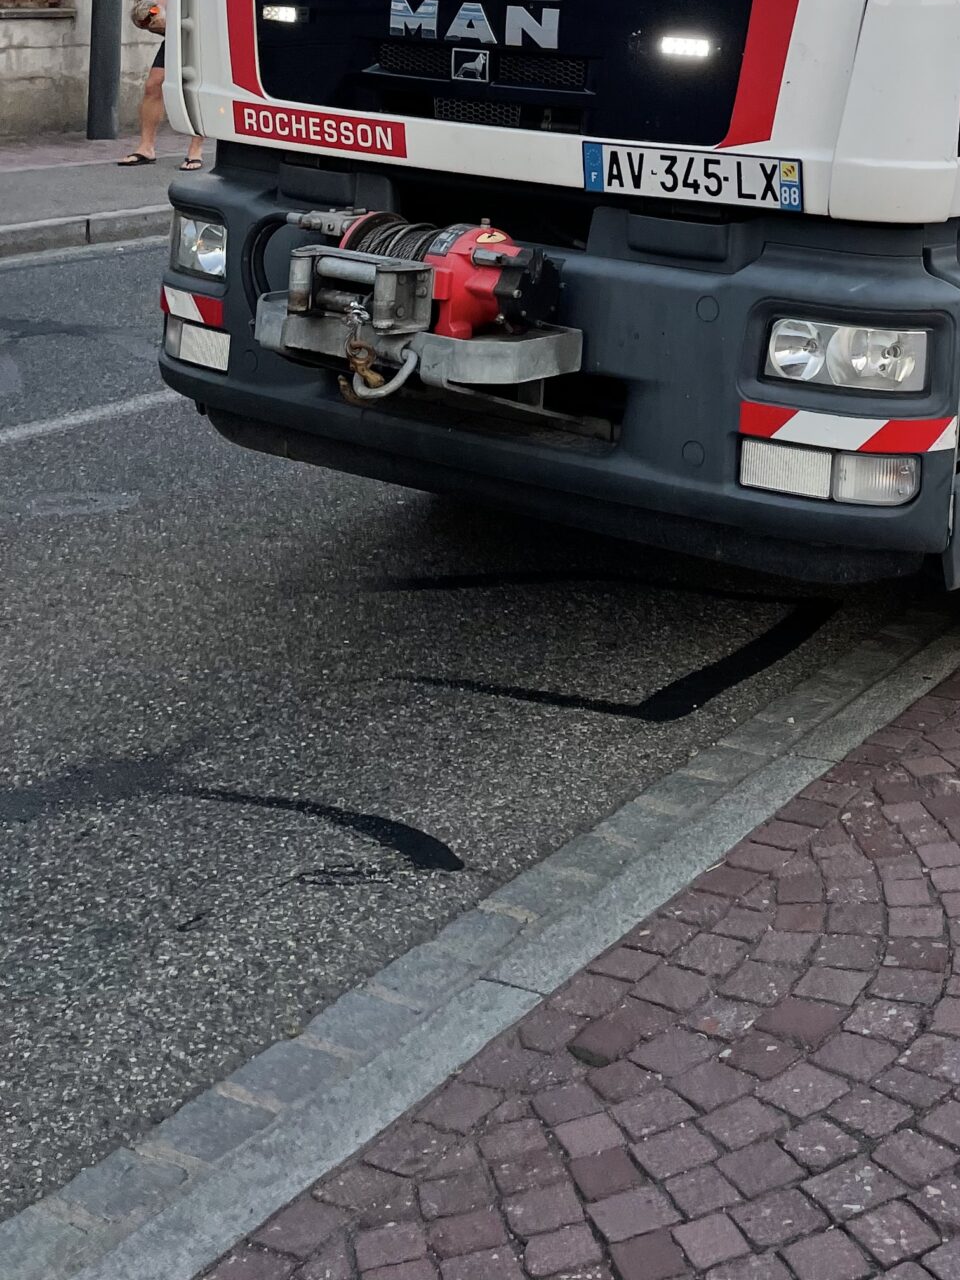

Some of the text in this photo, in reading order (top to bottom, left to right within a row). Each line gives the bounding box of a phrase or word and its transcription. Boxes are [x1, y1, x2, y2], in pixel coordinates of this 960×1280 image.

[244, 108, 393, 150] ROCHESSON
[591, 172, 597, 183] F
[781, 187, 800, 206] 88
